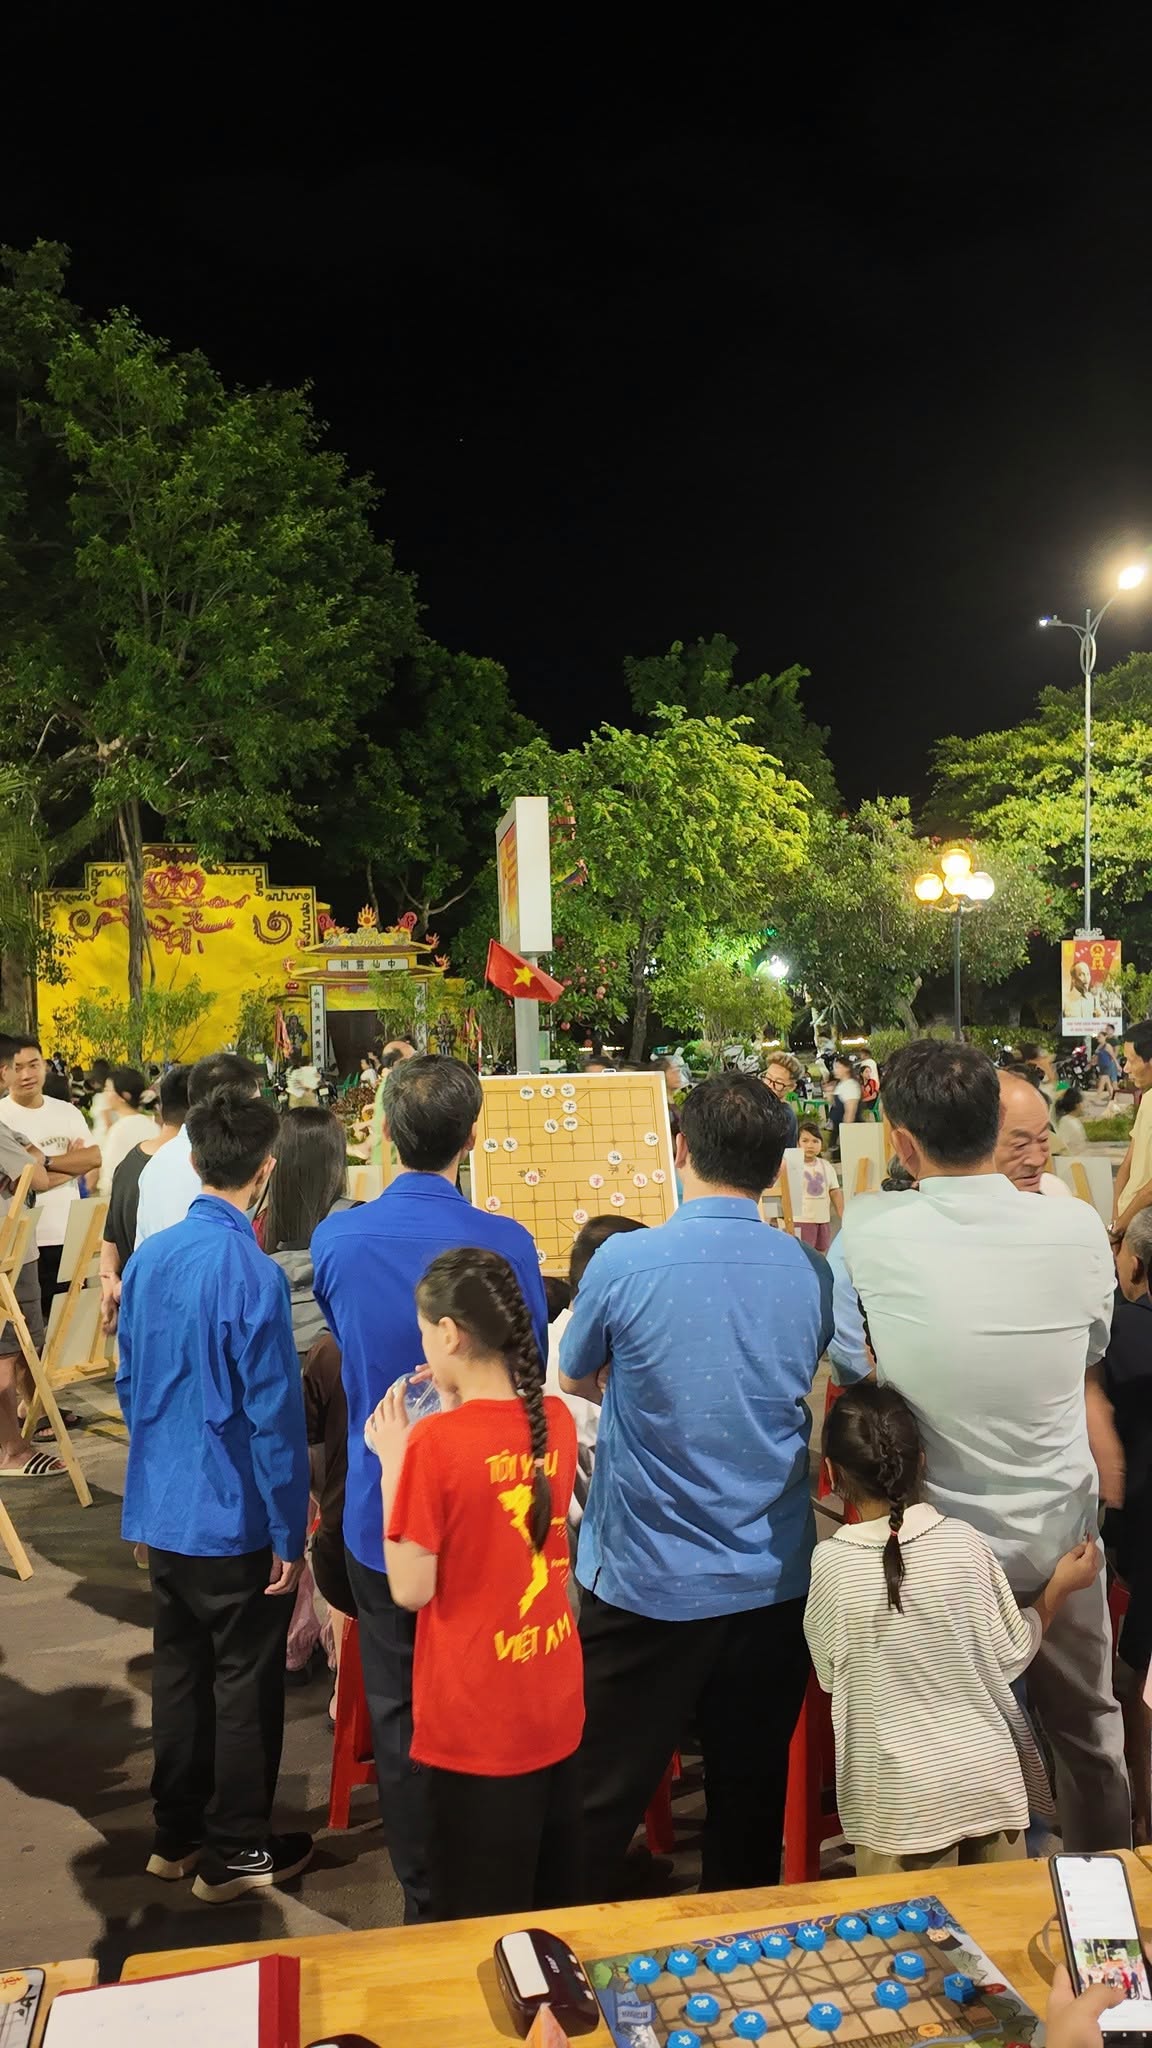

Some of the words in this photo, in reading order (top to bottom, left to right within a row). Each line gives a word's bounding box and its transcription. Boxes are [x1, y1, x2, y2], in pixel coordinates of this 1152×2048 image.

[484, 1448, 519, 1484] TÔI
[520, 1448, 559, 1481] YU
[493, 1623, 541, 1664] VIỆT
